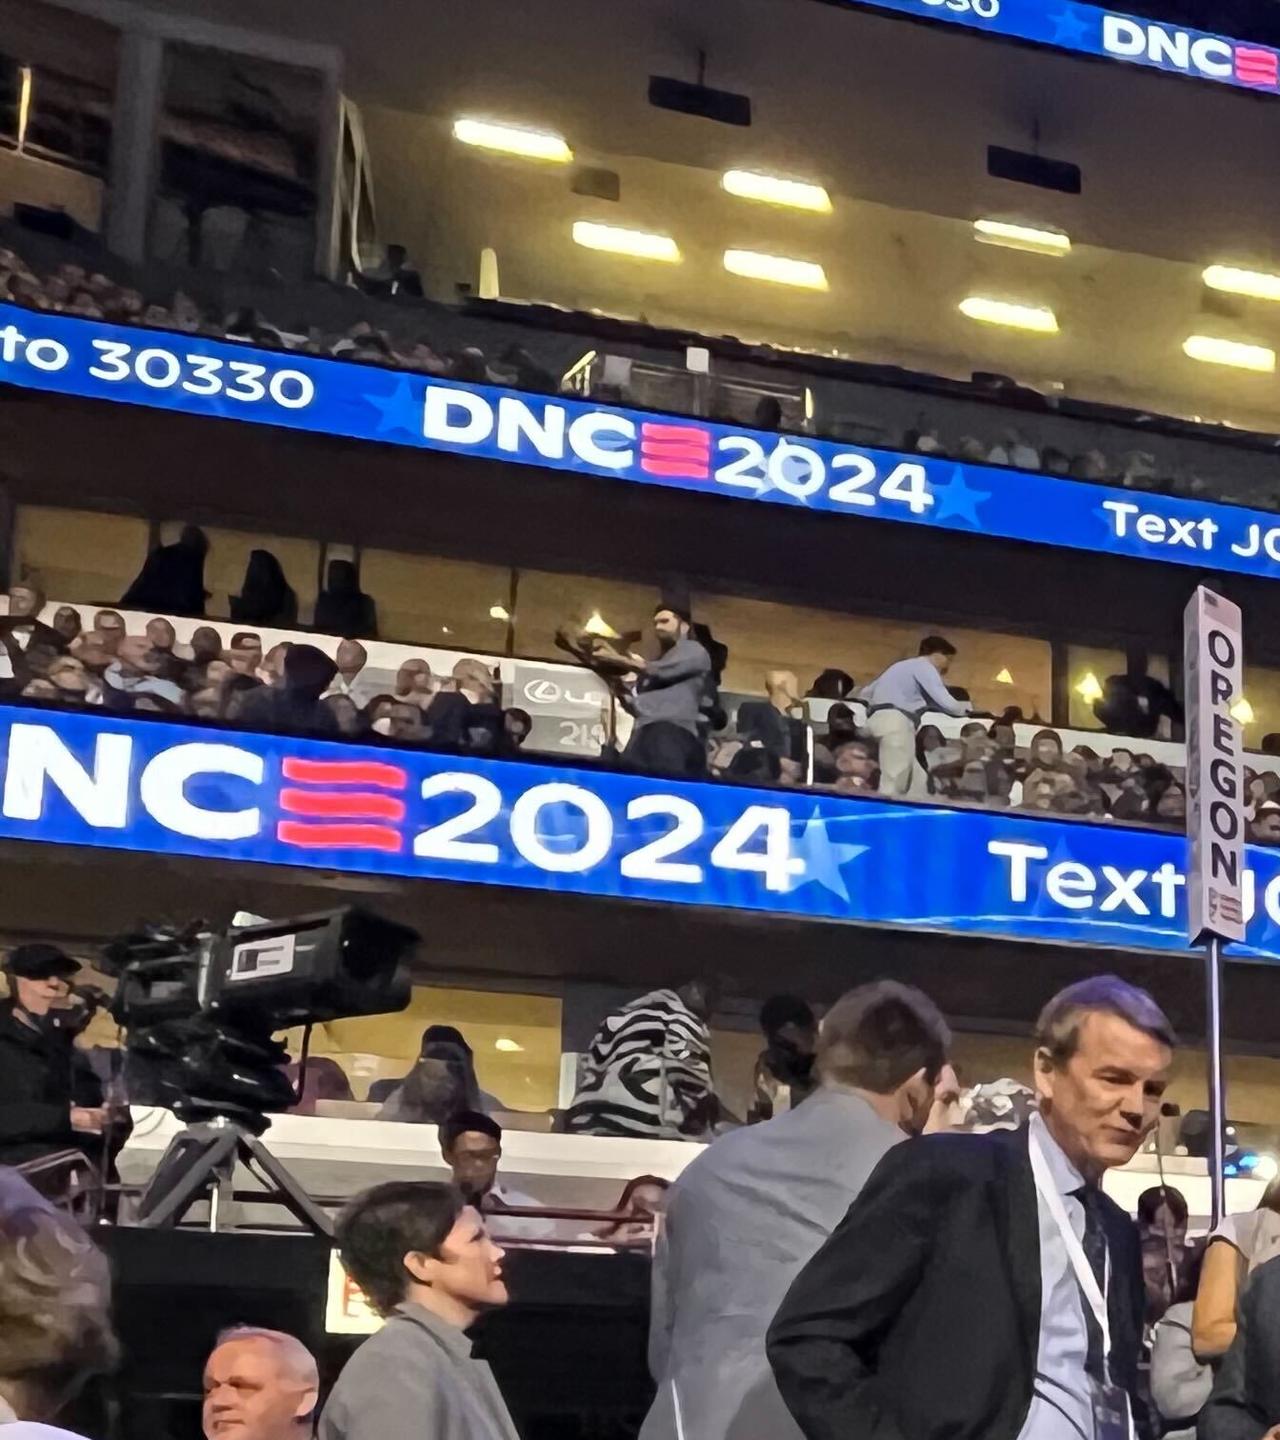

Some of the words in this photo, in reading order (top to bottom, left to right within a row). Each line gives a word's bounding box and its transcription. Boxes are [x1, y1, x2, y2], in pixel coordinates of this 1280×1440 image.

[1104, 16, 1232, 78] DNC
[0, 326, 68, 370] to
[90, 340, 313, 408] 30330
[424, 387, 636, 469] DNC
[715, 436, 933, 513] 2024
[1104, 502, 1217, 549] Text
[1208, 630, 1238, 887] OREGON
[414, 772, 804, 892] 2024
[988, 841, 1185, 917] Text
